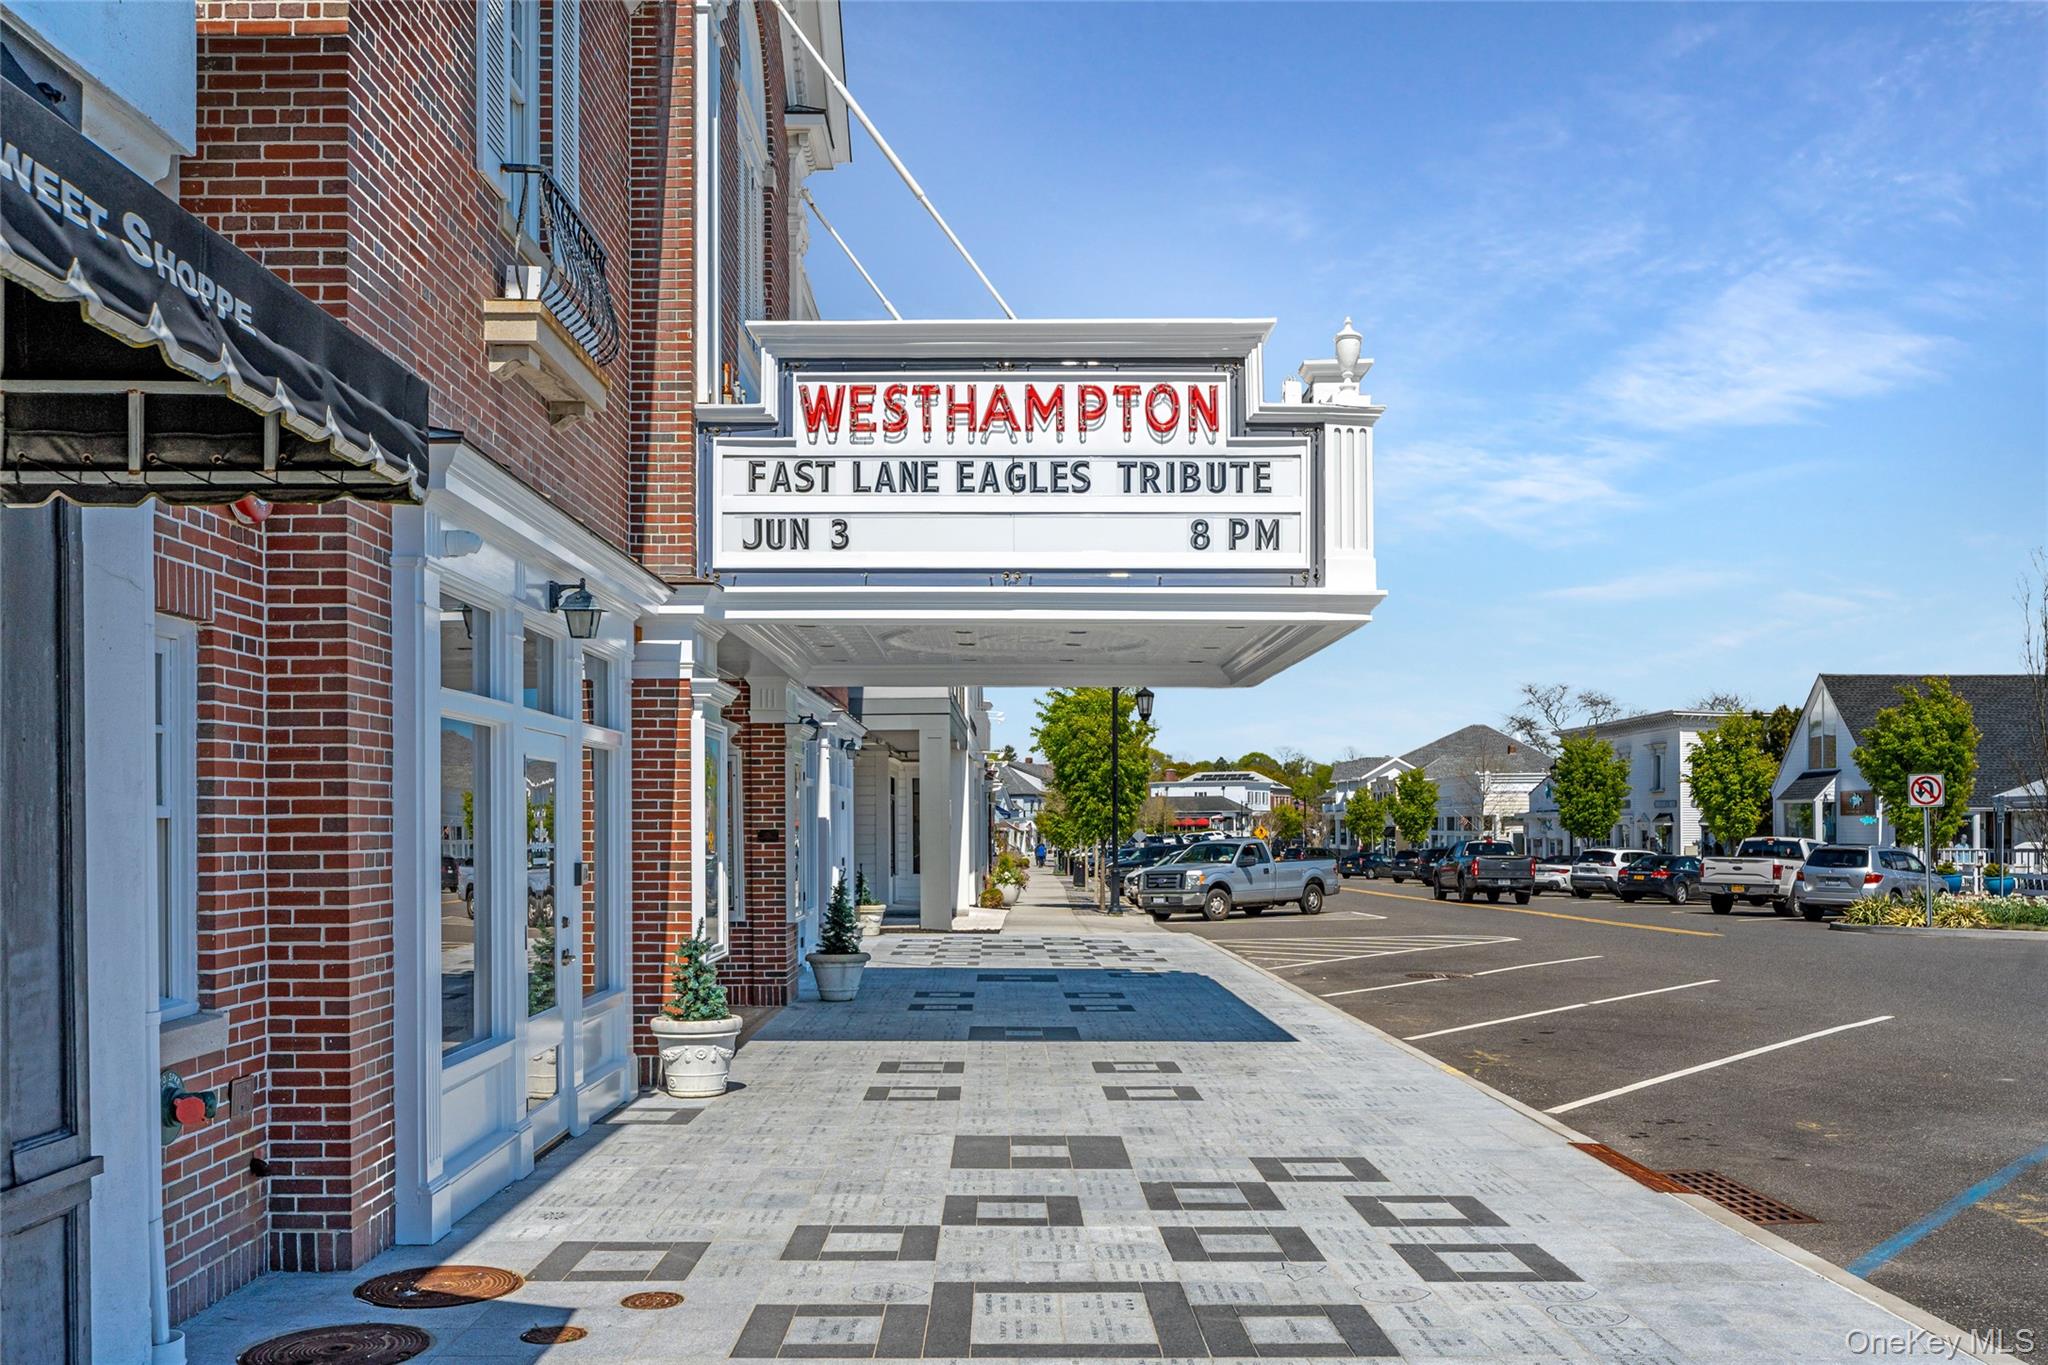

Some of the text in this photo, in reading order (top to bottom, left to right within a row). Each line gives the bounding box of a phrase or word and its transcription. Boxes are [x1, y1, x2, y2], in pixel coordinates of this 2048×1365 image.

[801, 383, 1220, 434] WESTHAMPTON
[748, 459, 1272, 495] FAST LANE EAGLES TRIBUTE
[742, 517, 1280, 551] JUN 3 8 PM
